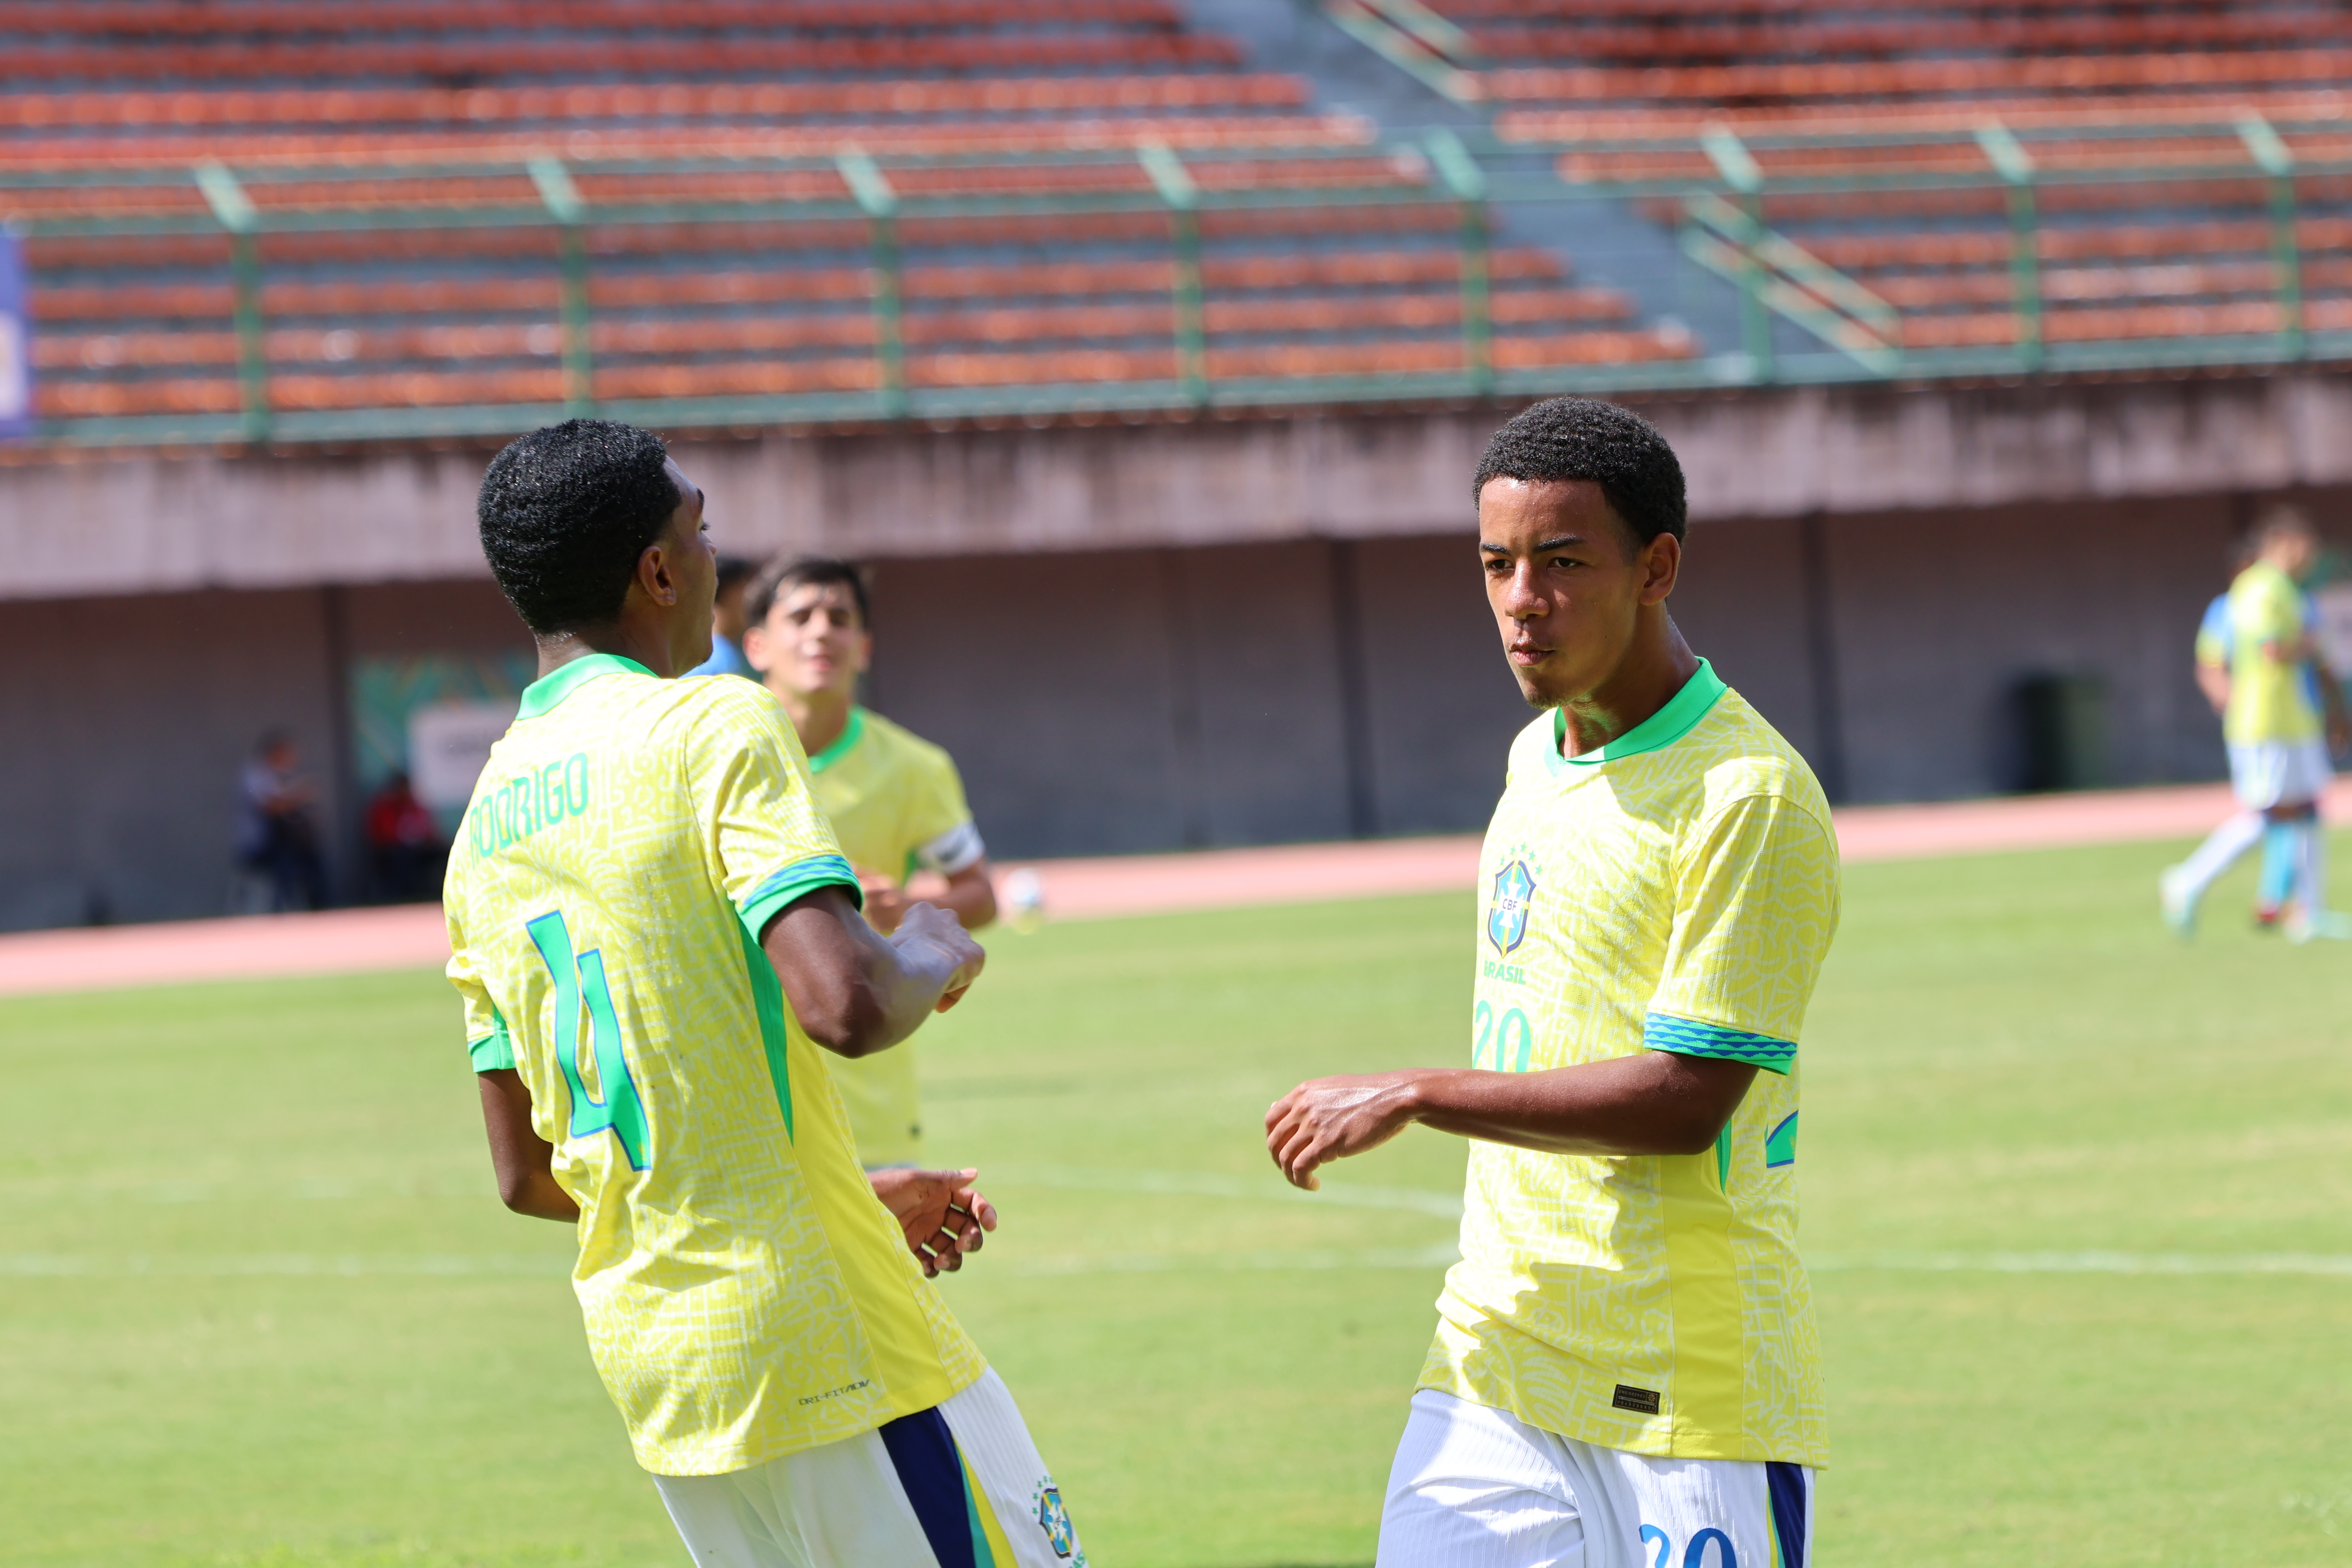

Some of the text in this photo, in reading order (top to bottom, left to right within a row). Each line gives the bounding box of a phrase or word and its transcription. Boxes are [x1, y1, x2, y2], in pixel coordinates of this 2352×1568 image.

[1503, 898, 1517, 911] CBF
[1484, 960, 1526, 985] BRASIL
[526, 909, 652, 1172] 4
[1473, 1000, 1532, 1073] 20
